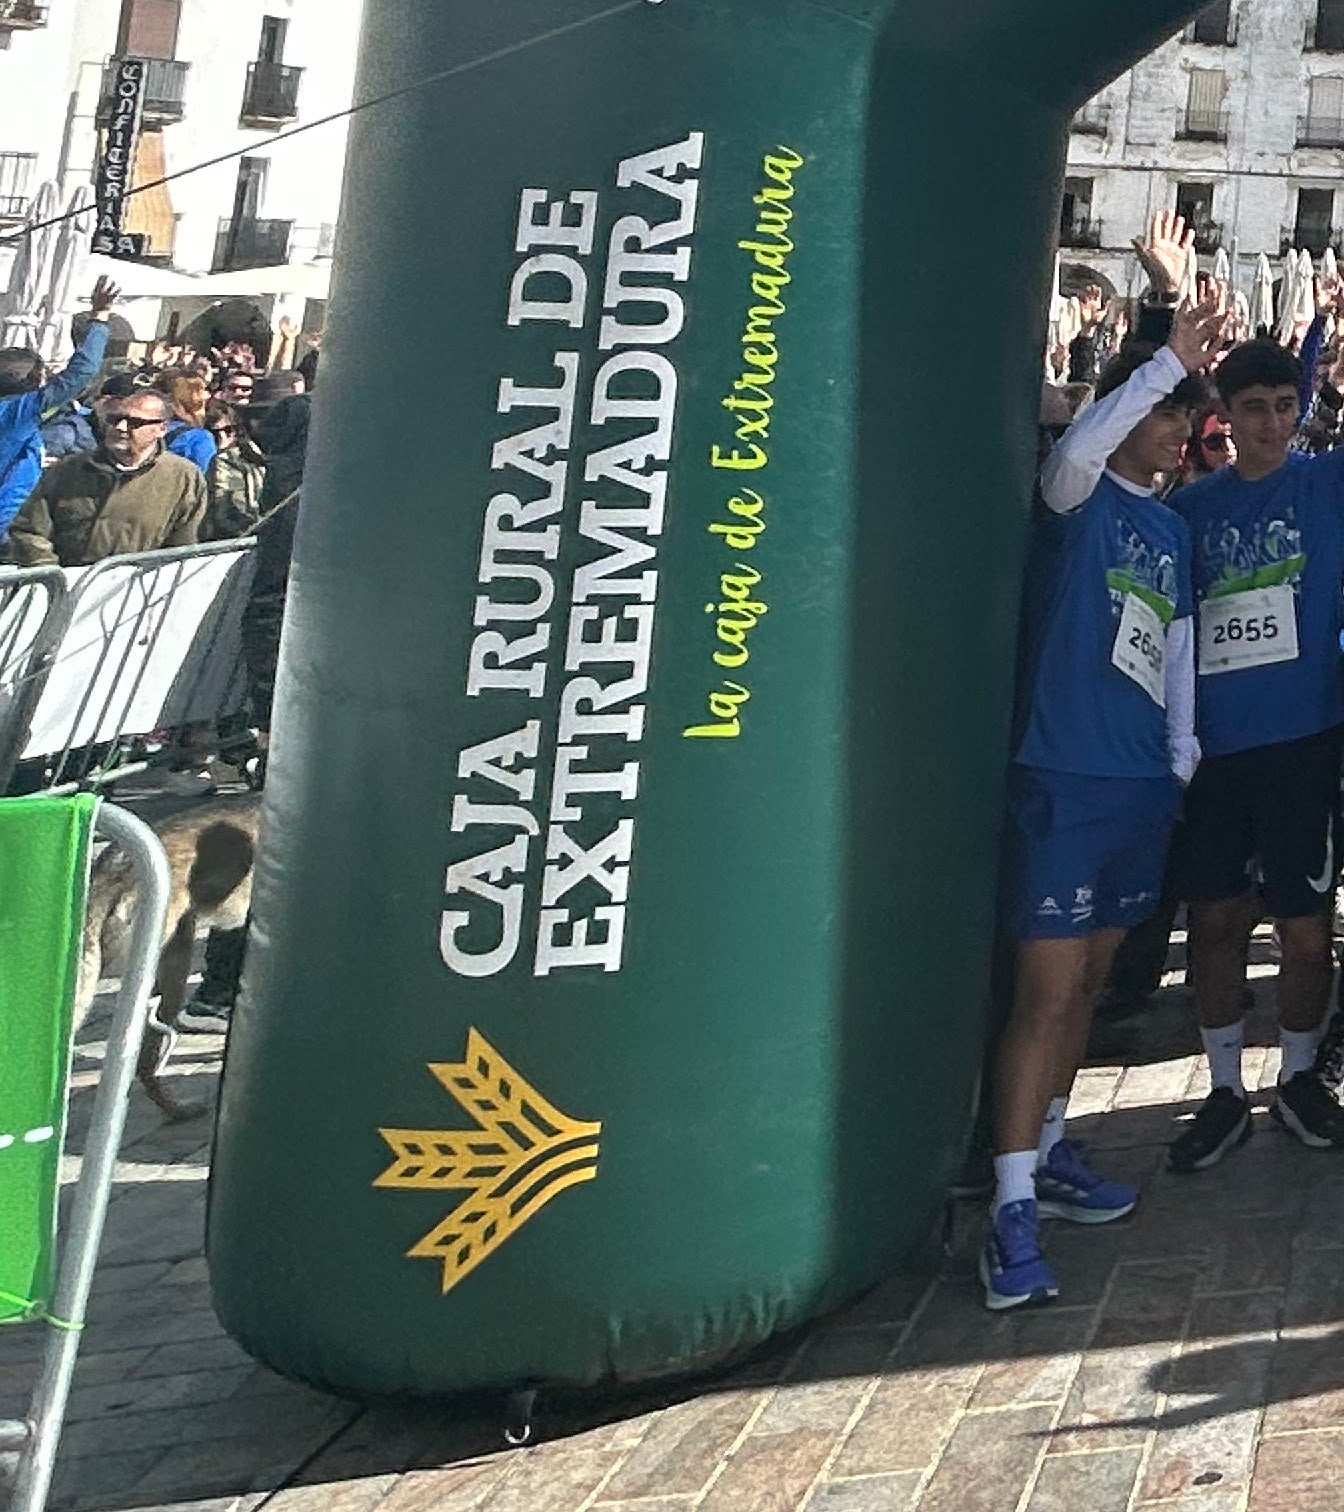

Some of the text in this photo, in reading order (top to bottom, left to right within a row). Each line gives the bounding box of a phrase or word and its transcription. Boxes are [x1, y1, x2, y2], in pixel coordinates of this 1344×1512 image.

[439, 187, 599, 978] CAJA RURAL DE
[532, 131, 704, 978] EXTREMADURA
[682, 143, 804, 739] La caja de Extremadura
[1212, 614, 1279, 644] 2655
